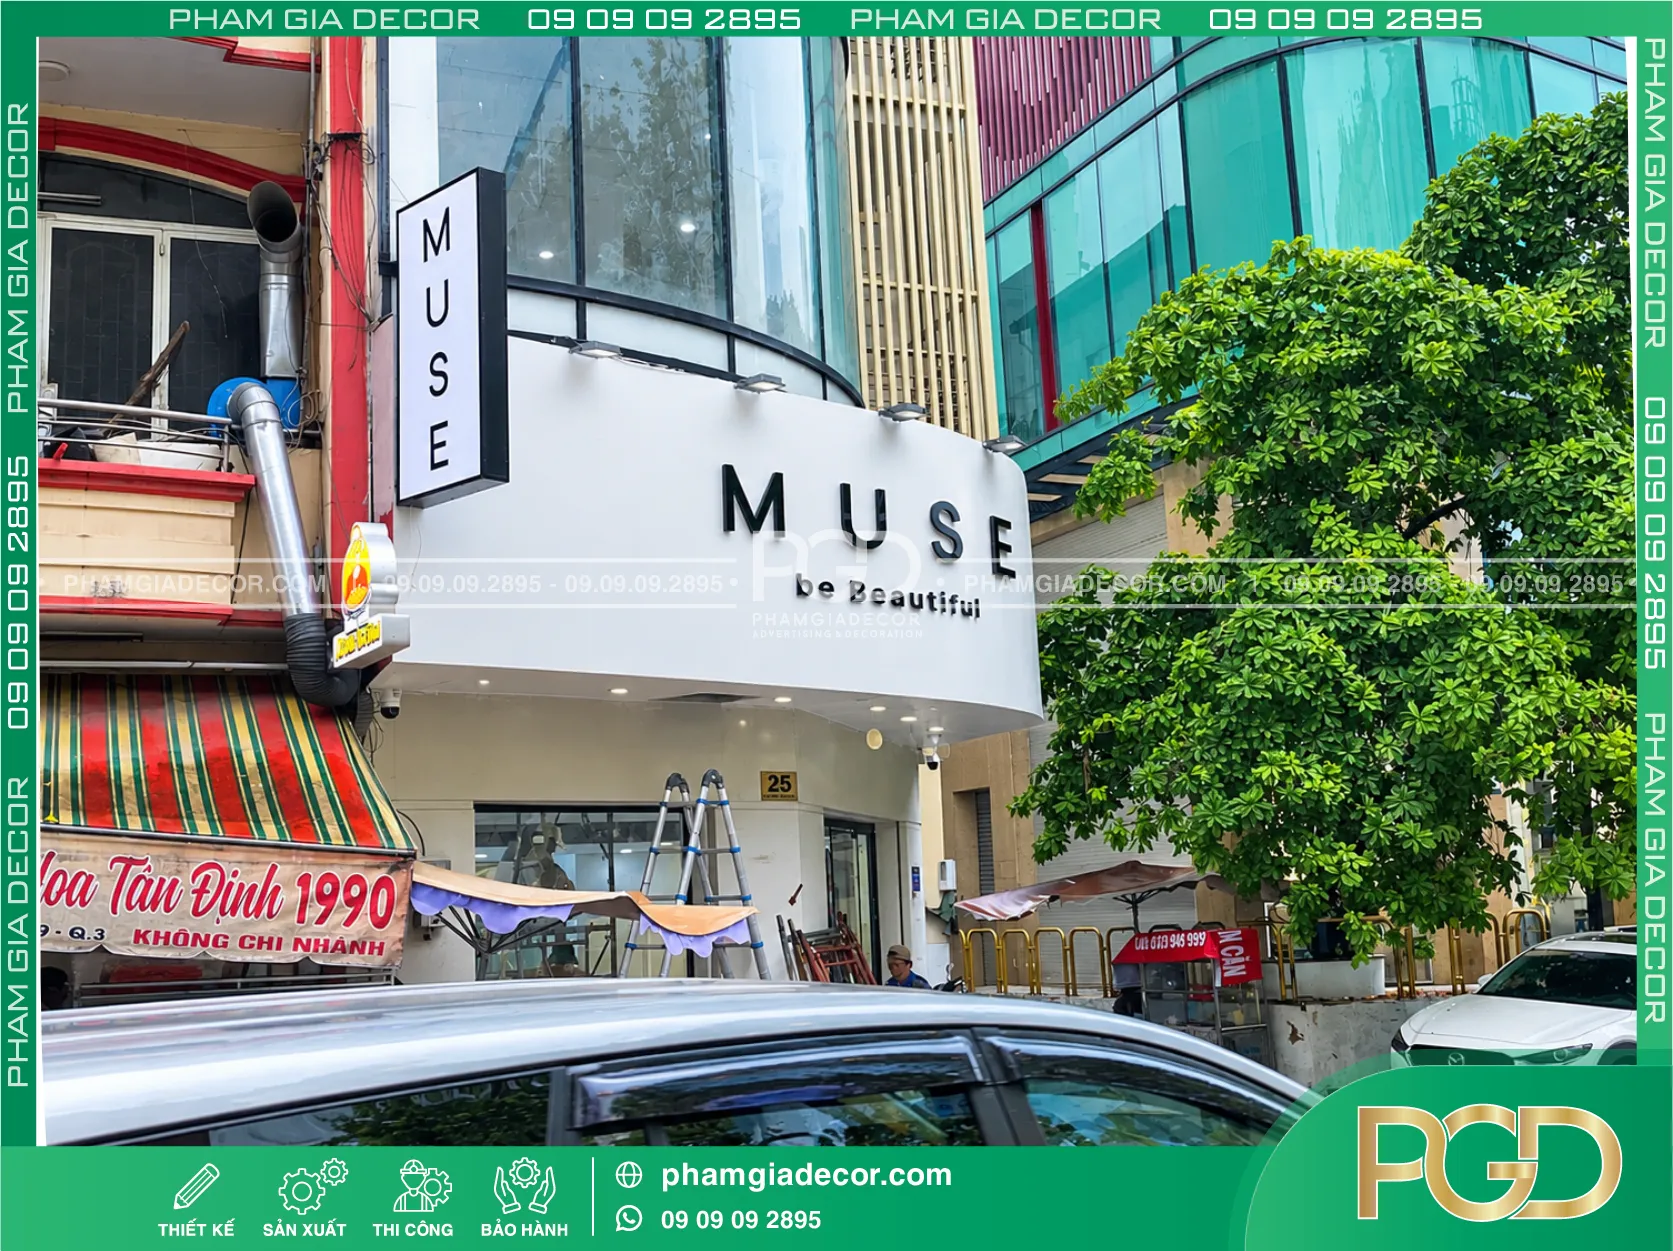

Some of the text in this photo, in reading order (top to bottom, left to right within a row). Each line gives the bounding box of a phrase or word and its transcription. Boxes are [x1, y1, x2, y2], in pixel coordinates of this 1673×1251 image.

[423, 206, 450, 471] MUSE
[722, 464, 1016, 579] MUSE
[796, 573, 980, 619] be Beautiful
[768, 774, 792, 792] 25
[109, 856, 183, 915] Tân
[191, 861, 284, 924] Định
[296, 872, 396, 930] 1990
[69, 926, 105, 941] Q.3
[133, 928, 229, 948] KHÔNG
[238, 935, 283, 950] CHI
